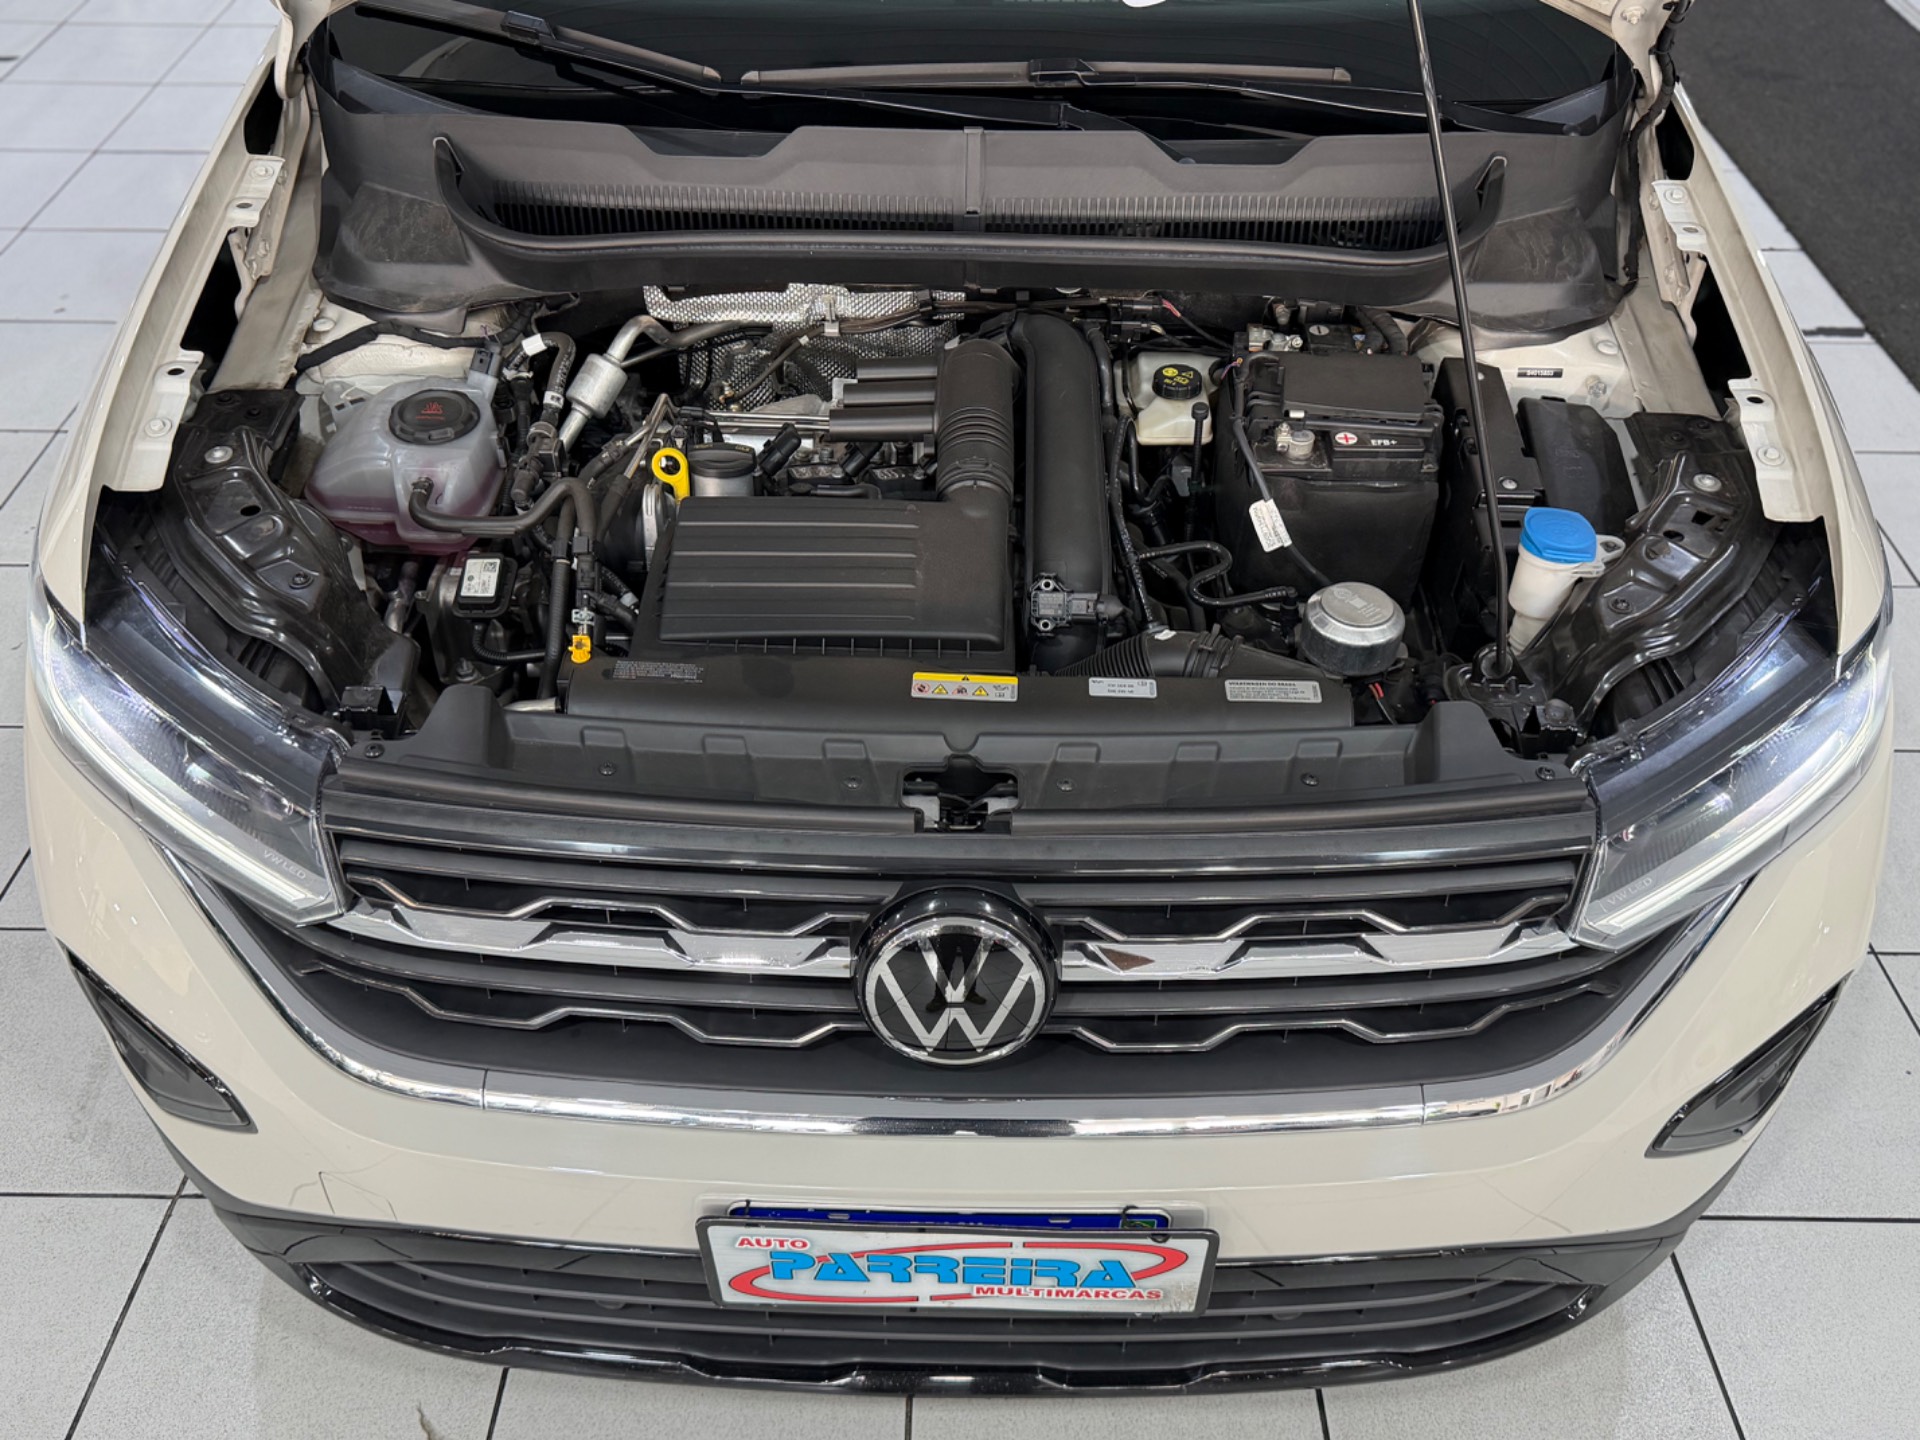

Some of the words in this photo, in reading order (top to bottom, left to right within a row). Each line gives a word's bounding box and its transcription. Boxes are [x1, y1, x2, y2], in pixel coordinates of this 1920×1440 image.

[282, 860, 306, 879] LED
[876, 934, 1036, 1052] VW
[737, 1236, 810, 1250] AUTO
[769, 1250, 1137, 1289] PARREIRA
[974, 1285, 1162, 1301] MULTIMARCAS
